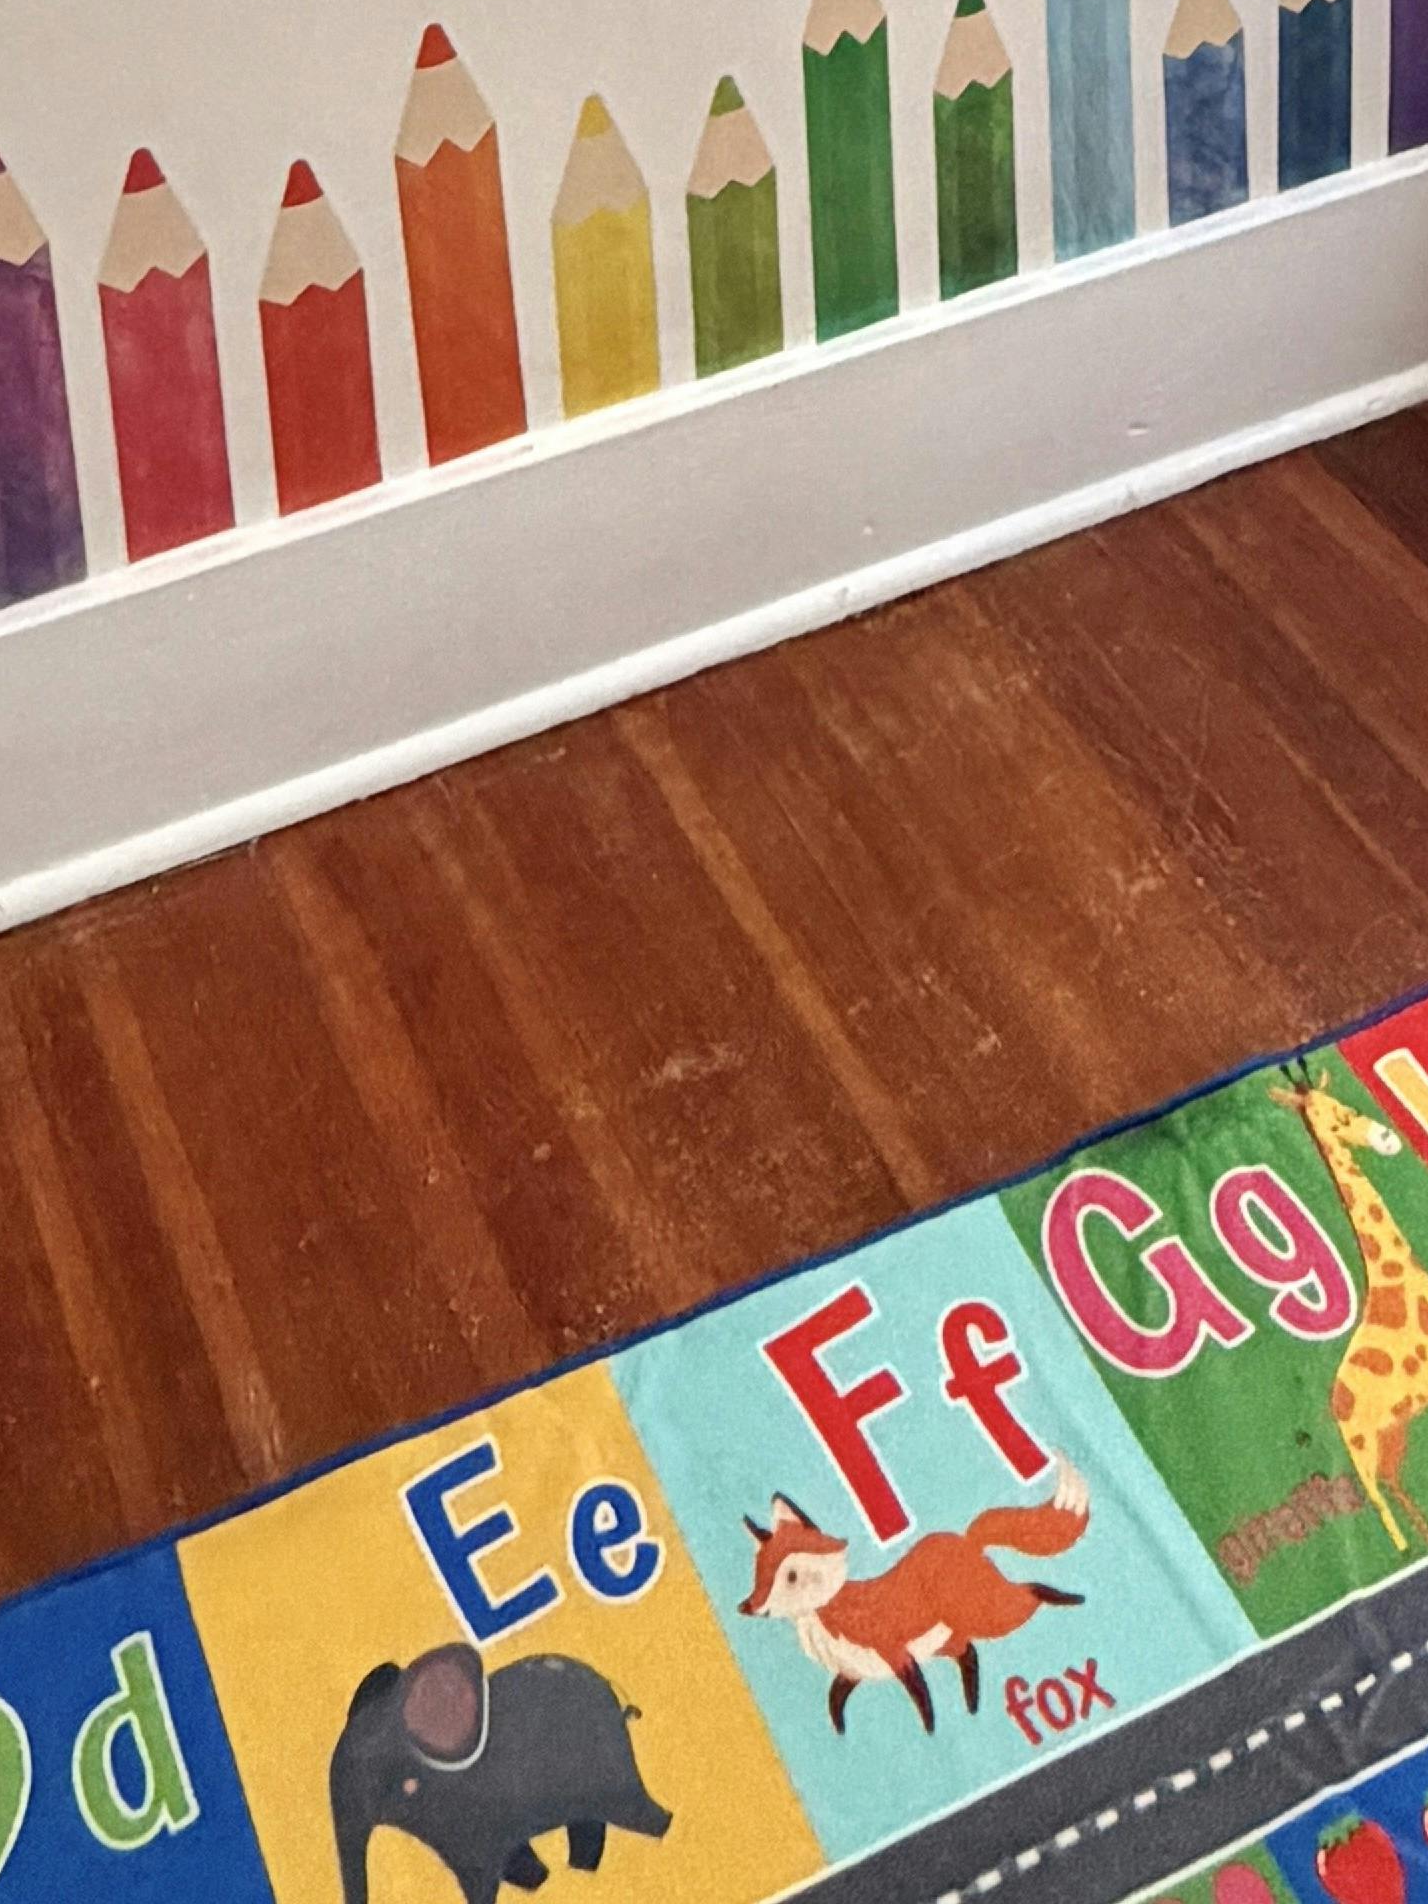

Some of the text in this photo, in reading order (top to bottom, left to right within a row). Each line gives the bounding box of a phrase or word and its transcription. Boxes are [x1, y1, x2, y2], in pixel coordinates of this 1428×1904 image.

[1040, 1165, 1362, 1377] Gg
[761, 1285, 1054, 1544] Ff
[401, 1436, 666, 1641] Ee
[1006, 1657, 1115, 1745] fox
